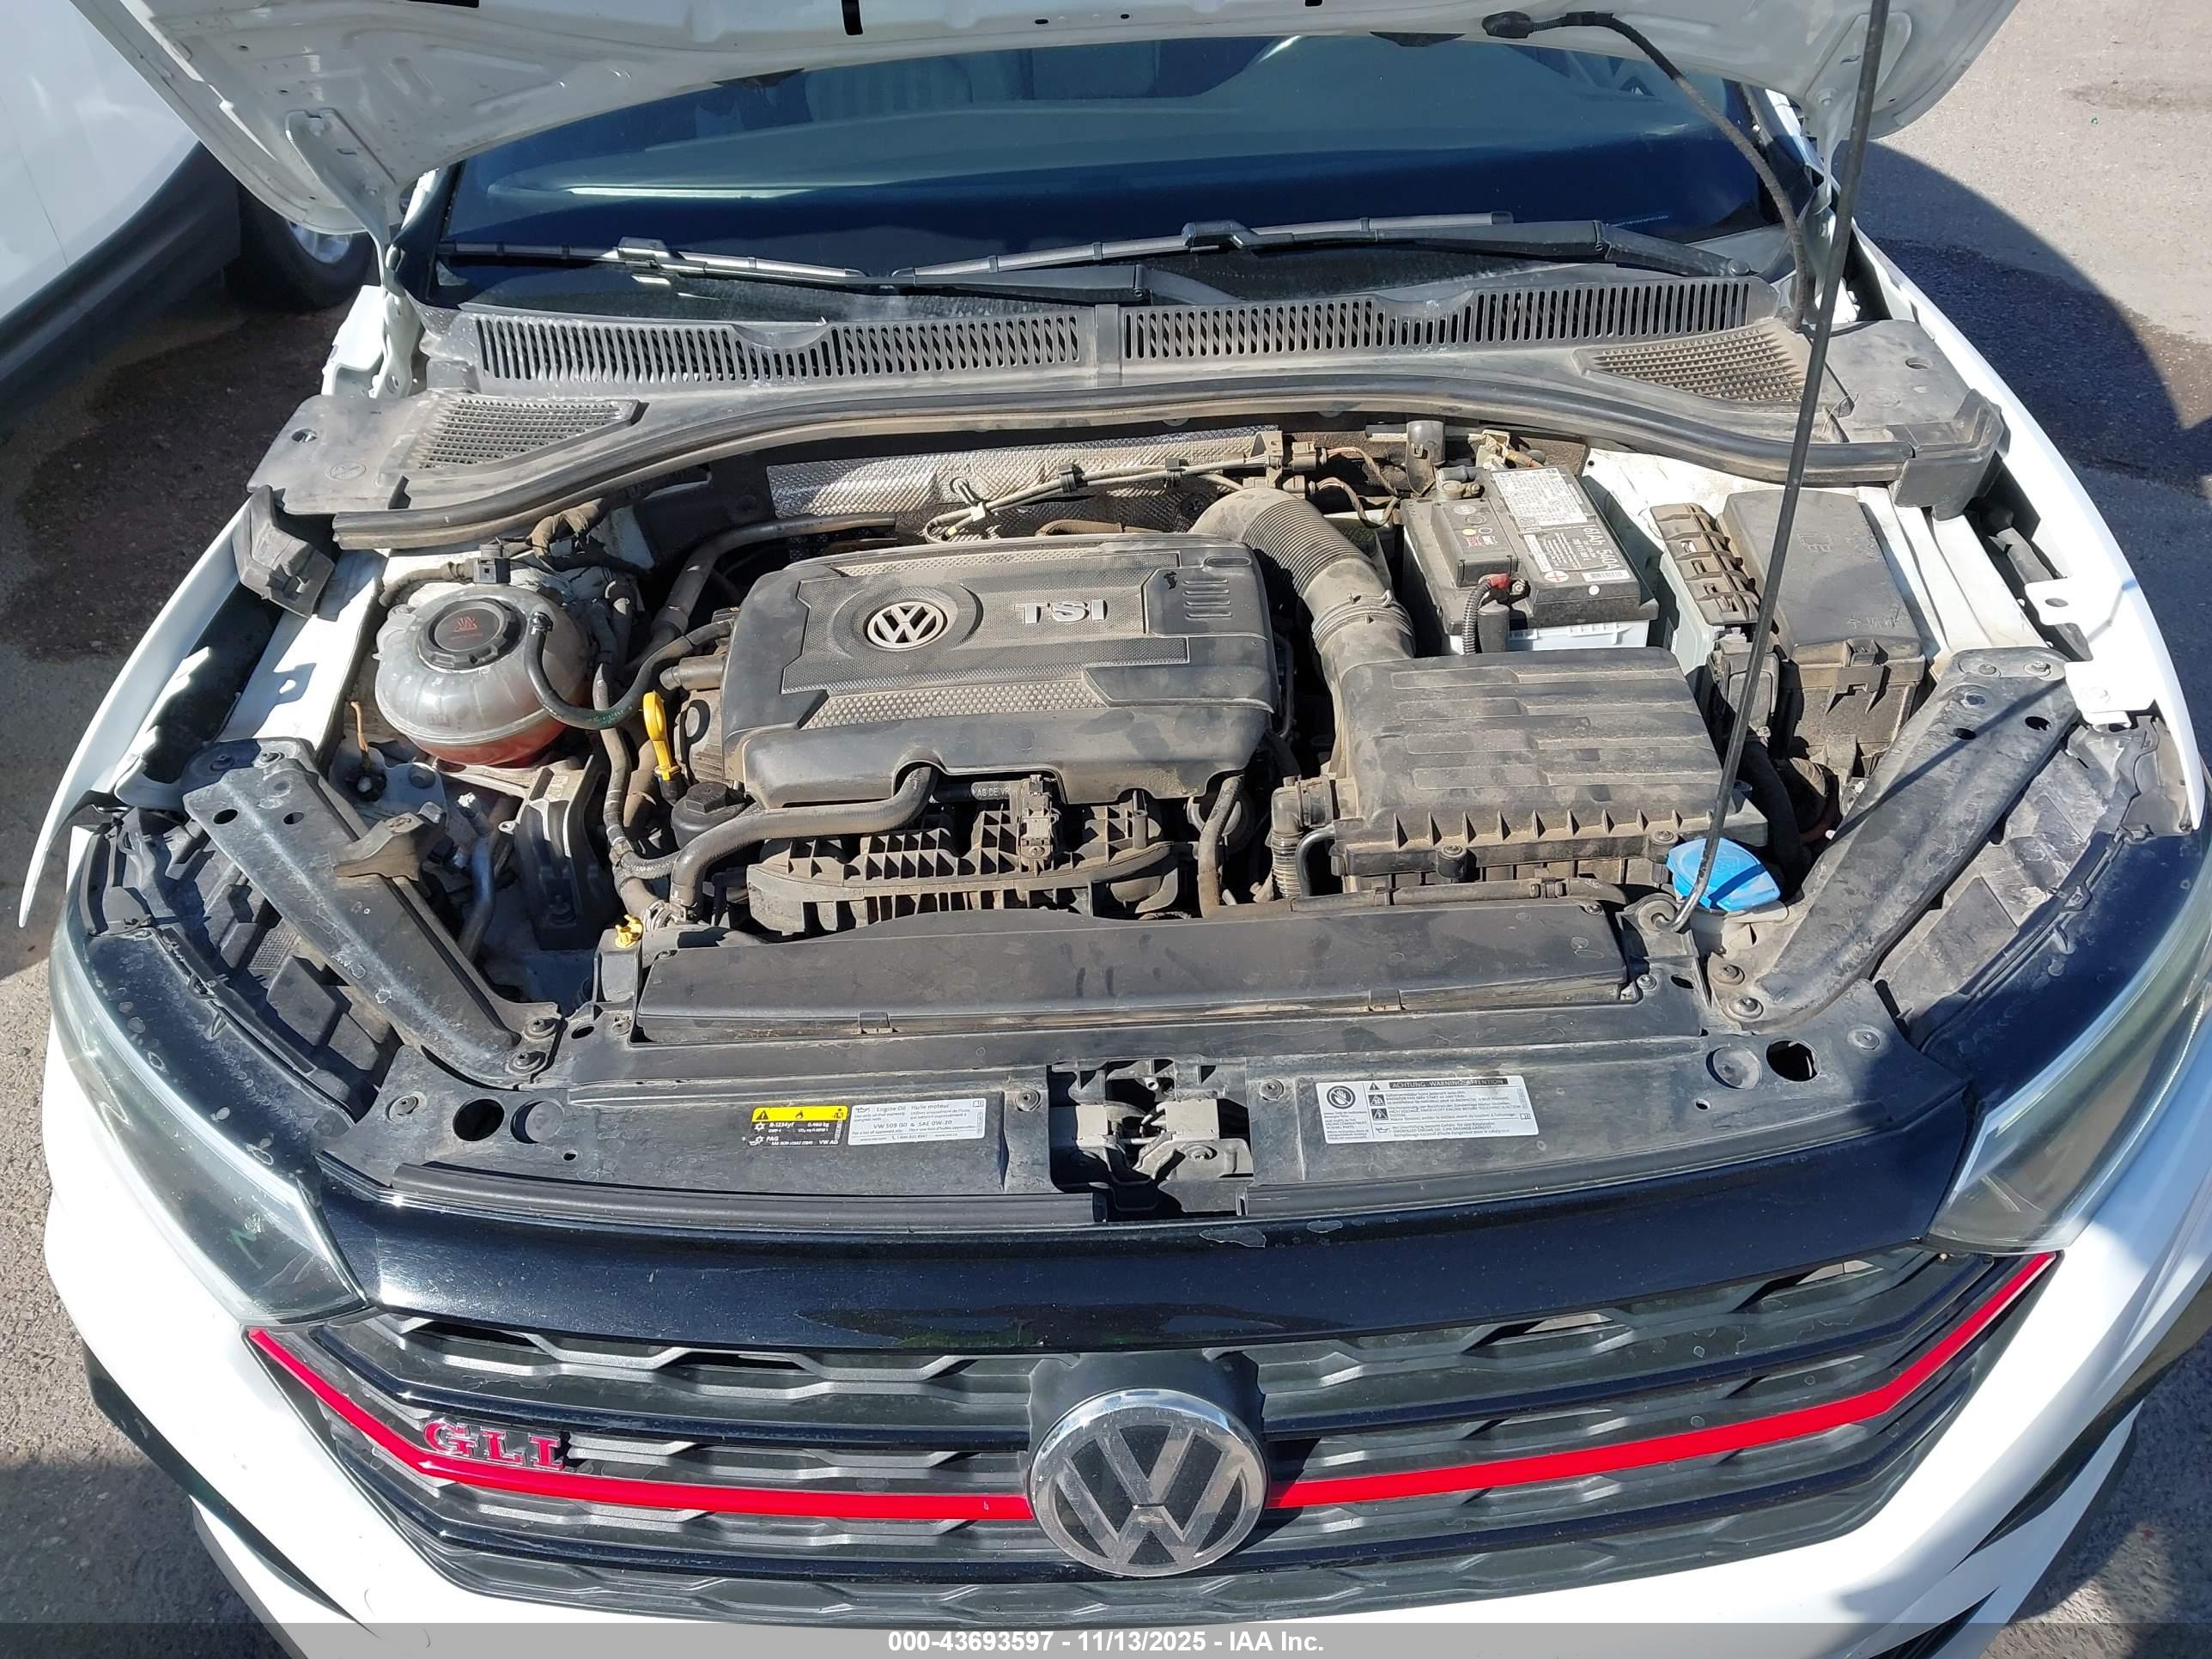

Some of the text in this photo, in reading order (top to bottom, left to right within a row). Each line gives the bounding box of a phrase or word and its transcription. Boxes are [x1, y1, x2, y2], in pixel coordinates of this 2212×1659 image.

[1583, 527, 1607, 546] 61Ah
[1596, 549, 1622, 570] 540A
[1015, 599, 1108, 625] TSI
[423, 1418, 564, 1471] GLI
